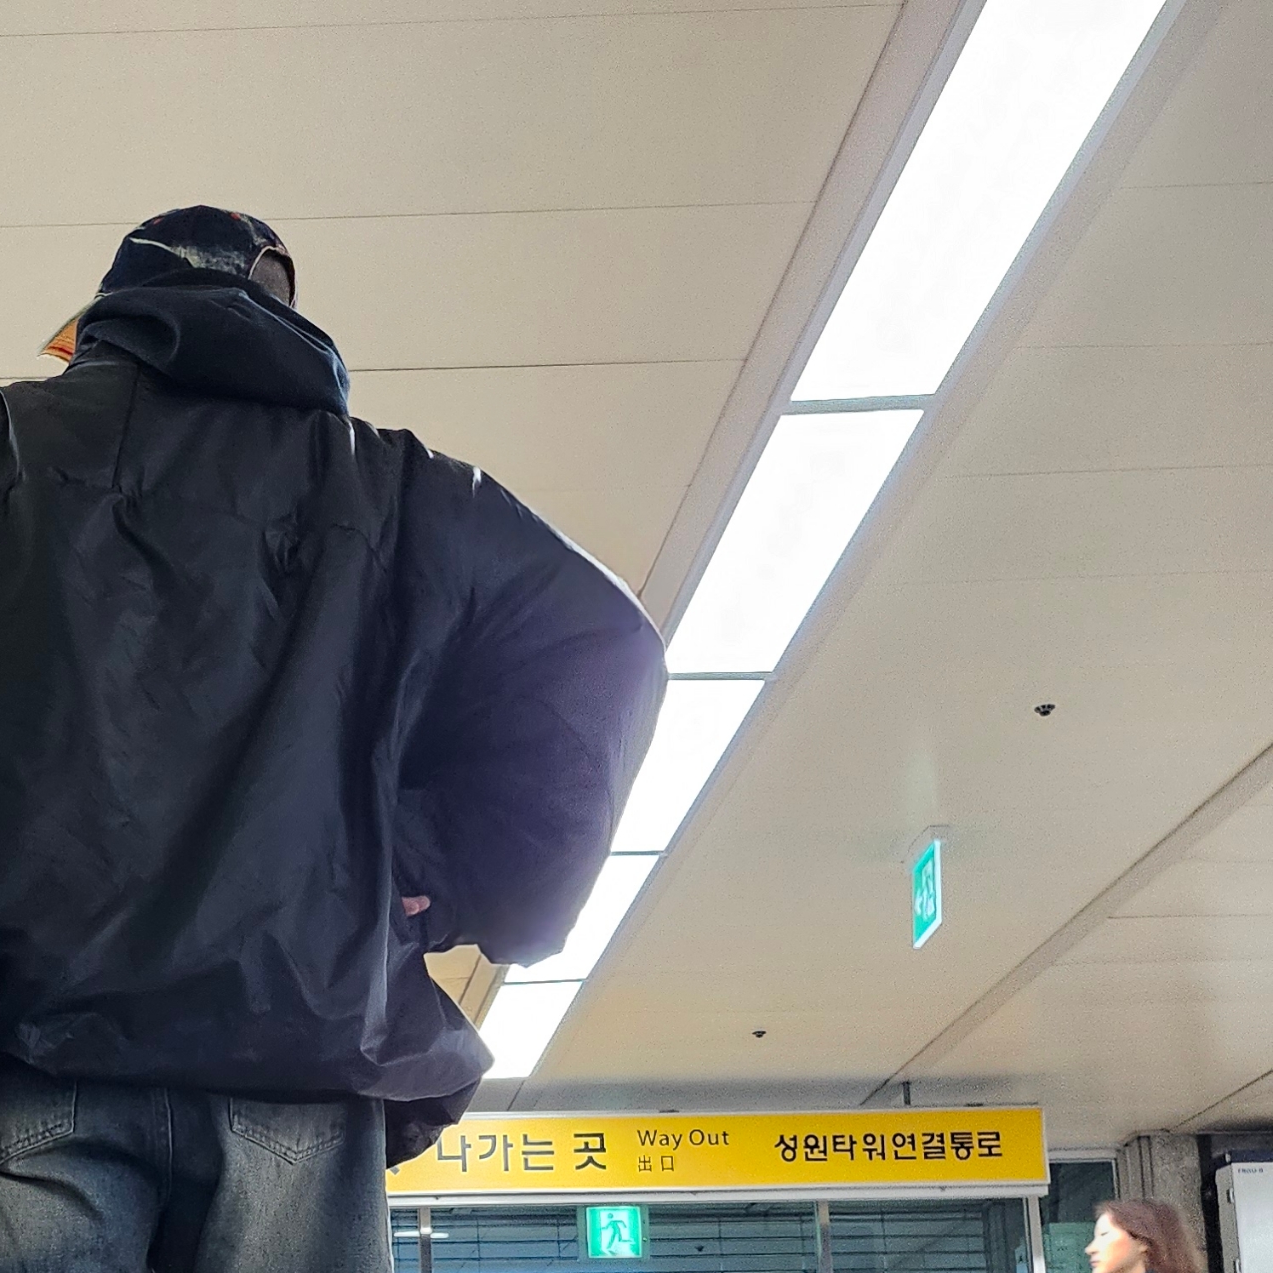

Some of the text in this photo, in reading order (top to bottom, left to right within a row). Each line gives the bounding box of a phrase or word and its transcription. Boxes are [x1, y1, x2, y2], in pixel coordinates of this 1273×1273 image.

[437, 1132, 607, 1173] 나가는 곳
[637, 1128, 730, 1151] Way Out
[774, 1131, 1003, 1163] 성원타워연결통로
[637, 1154, 675, 1173] 出口
